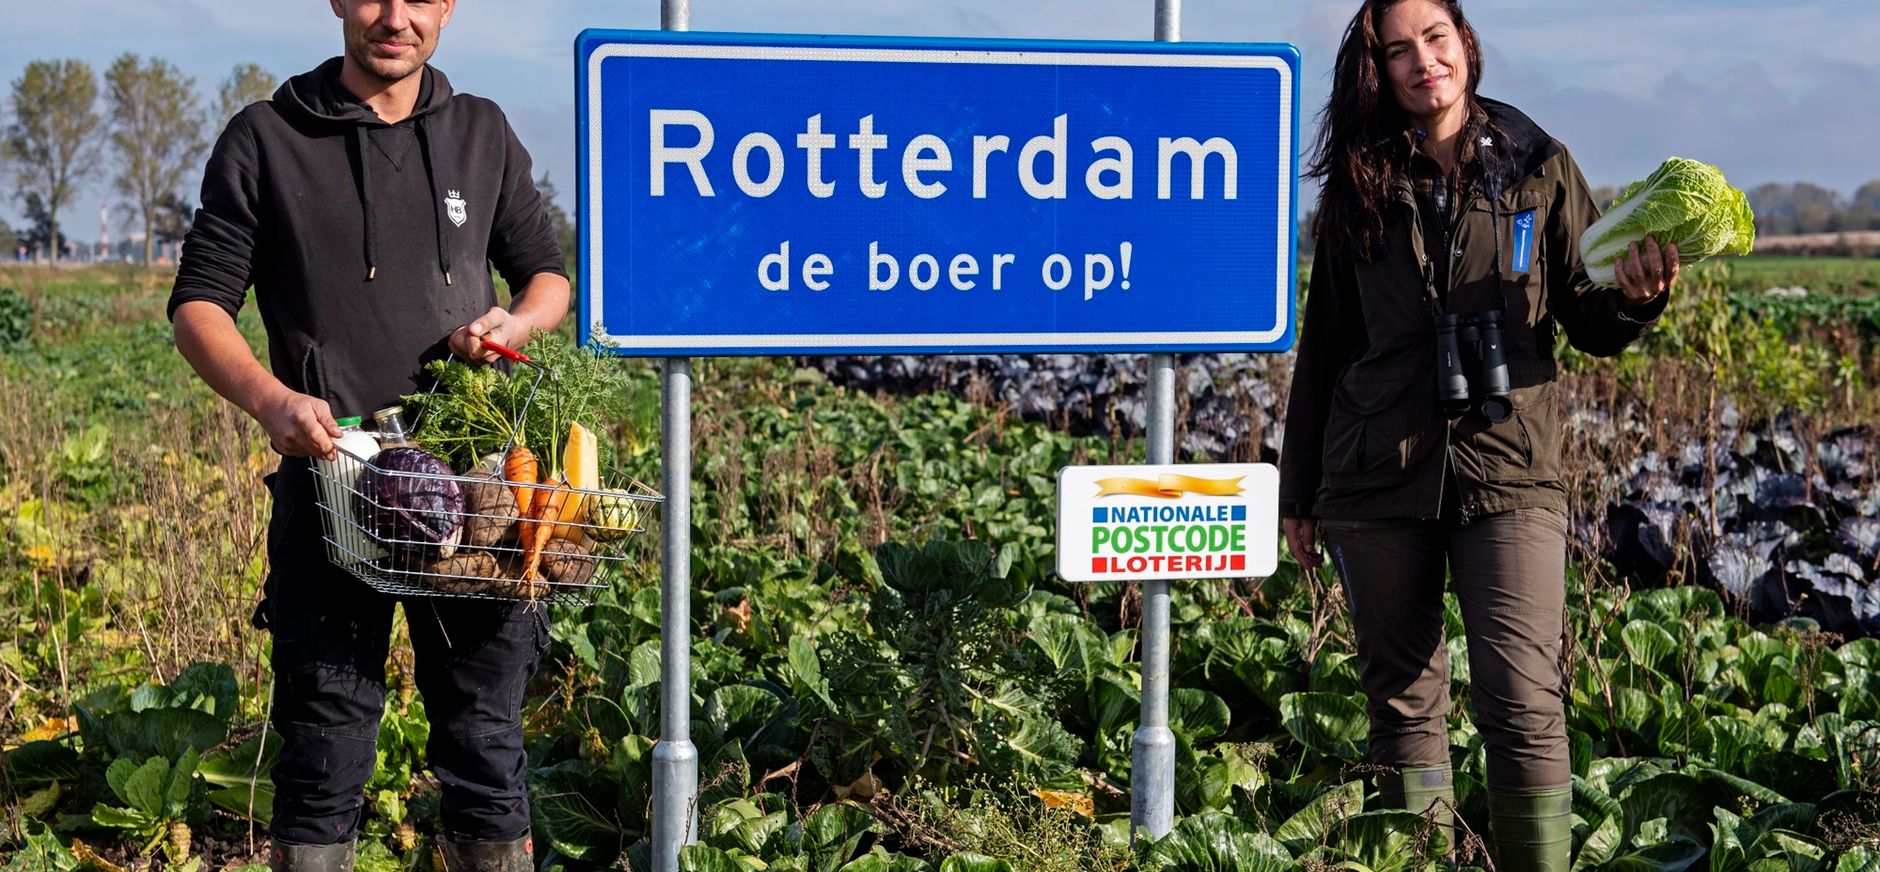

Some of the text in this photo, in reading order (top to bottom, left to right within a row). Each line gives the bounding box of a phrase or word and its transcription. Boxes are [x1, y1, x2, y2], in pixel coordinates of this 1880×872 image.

[649, 109, 1238, 200] Rotterdam
[757, 241, 1133, 301] de boer op!
[1111, 505, 1228, 523] NATIONALE
[1092, 524, 1246, 554] POSTCODE
[1111, 555, 1227, 573] LOTERIJ
